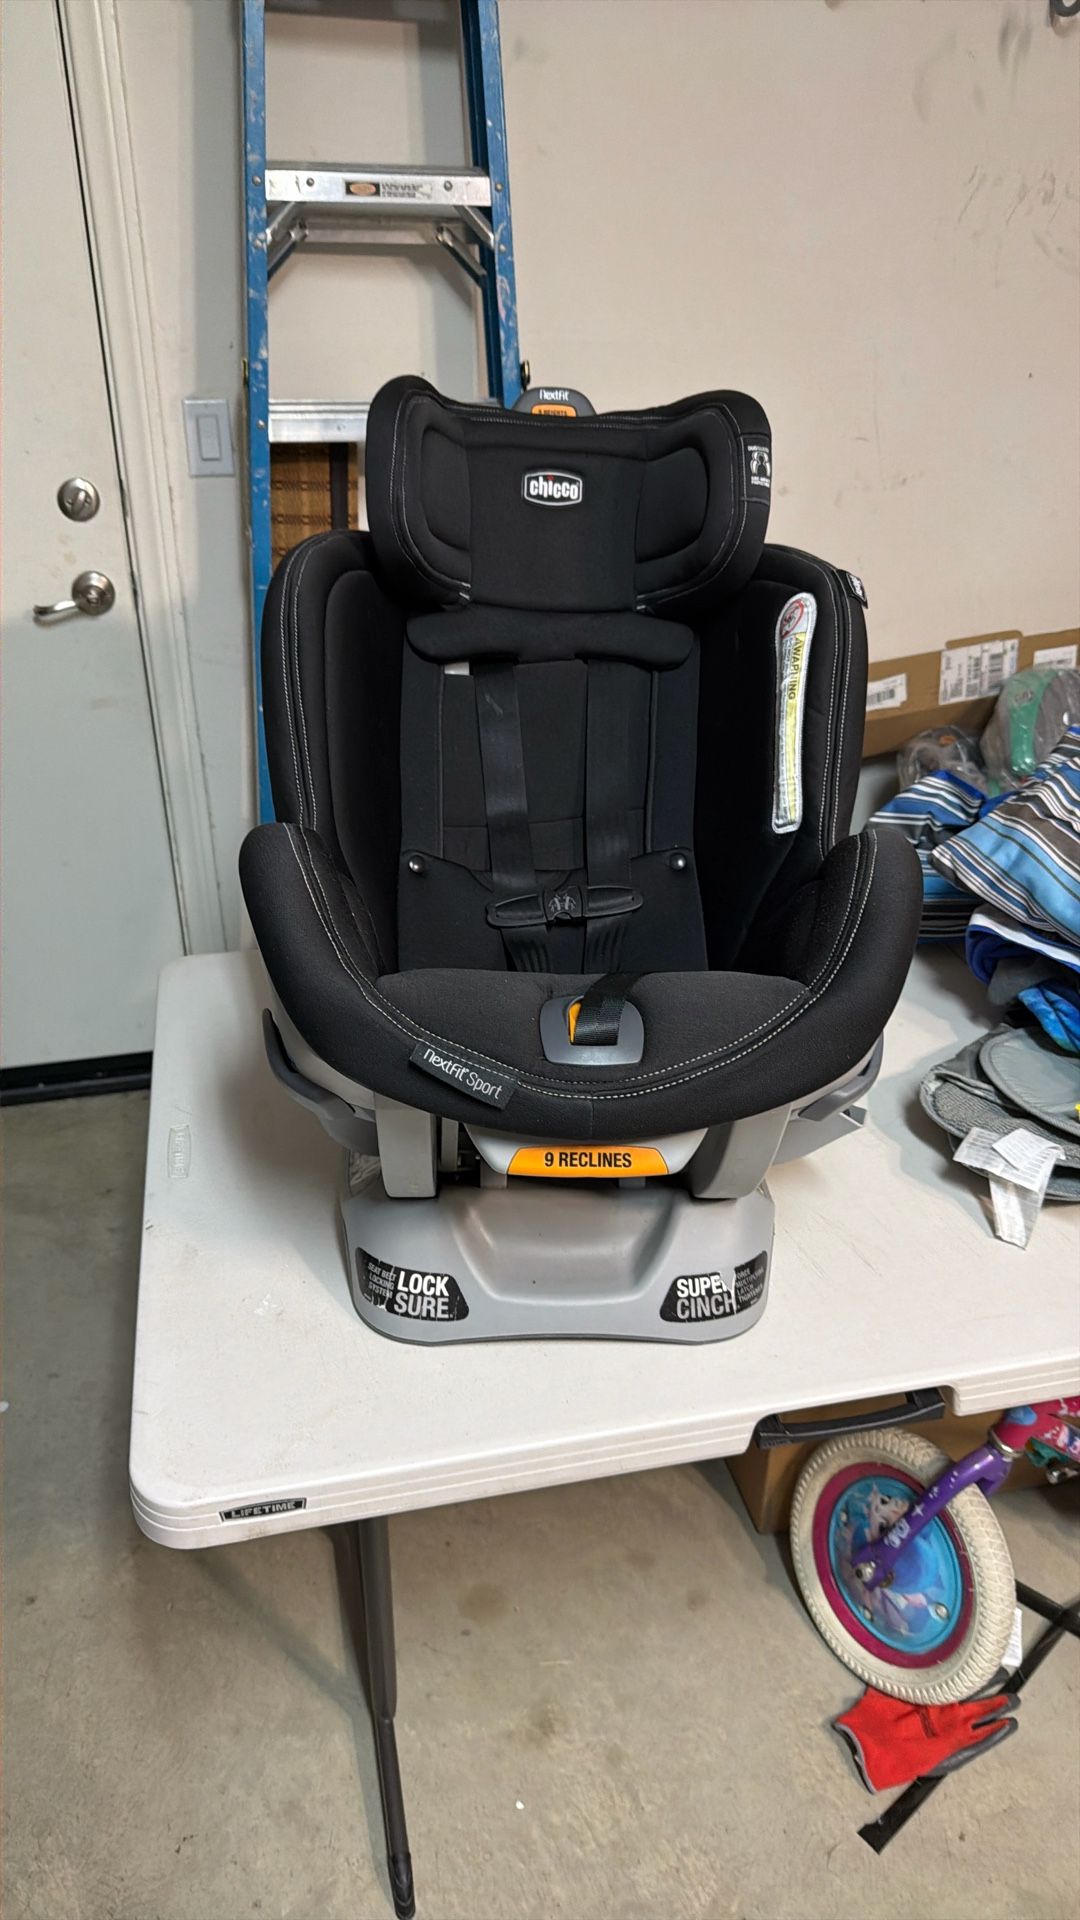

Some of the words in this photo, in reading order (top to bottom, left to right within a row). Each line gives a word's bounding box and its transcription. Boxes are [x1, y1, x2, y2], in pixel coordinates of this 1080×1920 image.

[529, 475, 579, 500] chicco
[466, 1071, 503, 1099] Sport
[544, 1152, 554, 1167] 9
[558, 1152, 632, 1168] RECLINES
[368, 1262, 382, 1275] SEAT
[397, 1271, 450, 1296] LOCK
[231, 1501, 296, 1518] LIFETIME
